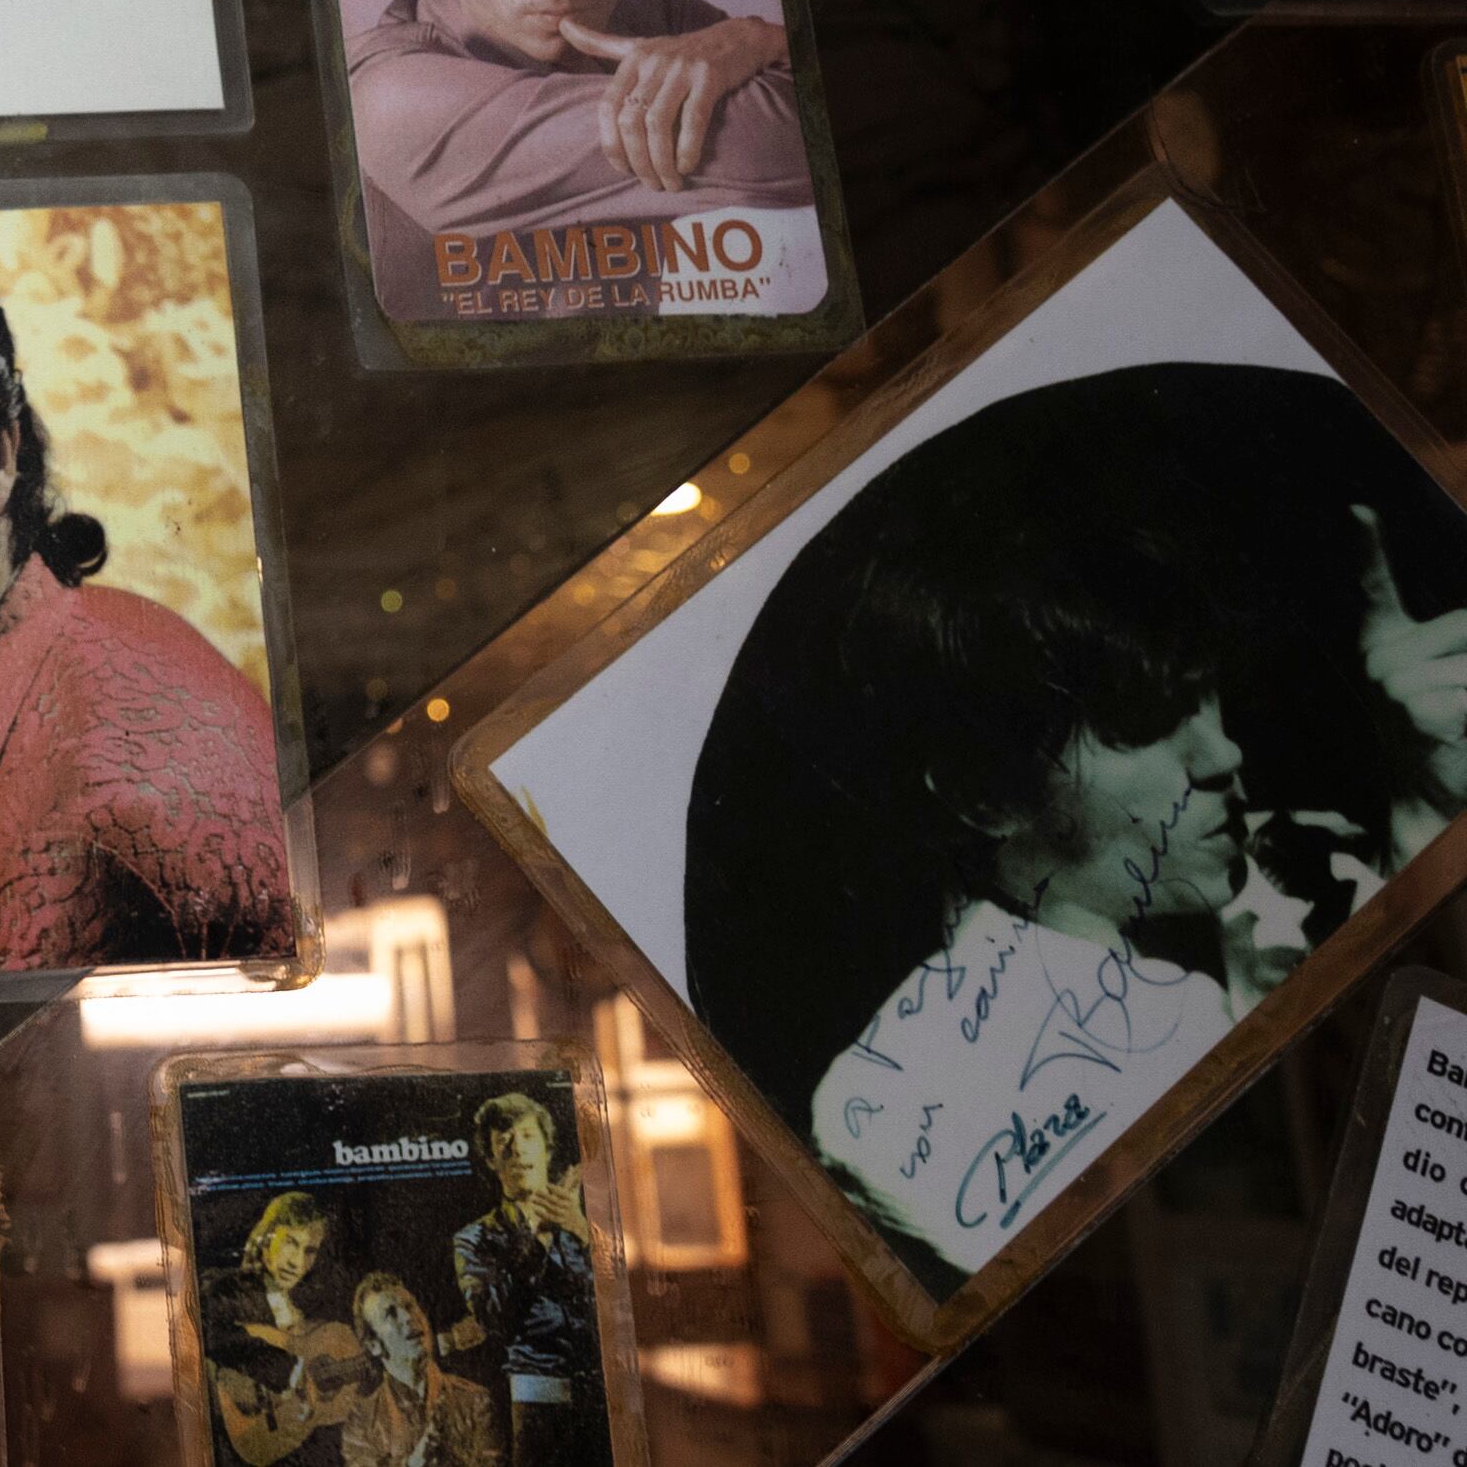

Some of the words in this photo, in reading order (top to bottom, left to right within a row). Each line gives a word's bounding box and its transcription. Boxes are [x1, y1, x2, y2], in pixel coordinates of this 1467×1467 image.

[434, 219, 763, 287] BAMBINO
[442, 290, 492, 315] "EL
[499, 287, 557, 313] REY
[567, 286, 605, 310] DE
[614, 284, 651, 307] LA
[658, 276, 772, 304] RUMBA"
[1427, 1049, 1467, 1089] Ba
[1414, 1102, 1467, 1142] con
[333, 1136, 470, 1168] bambino
[1402, 1148, 1447, 1183] dio
[1377, 1246, 1421, 1281] del
[1365, 1298, 1432, 1340] cano
